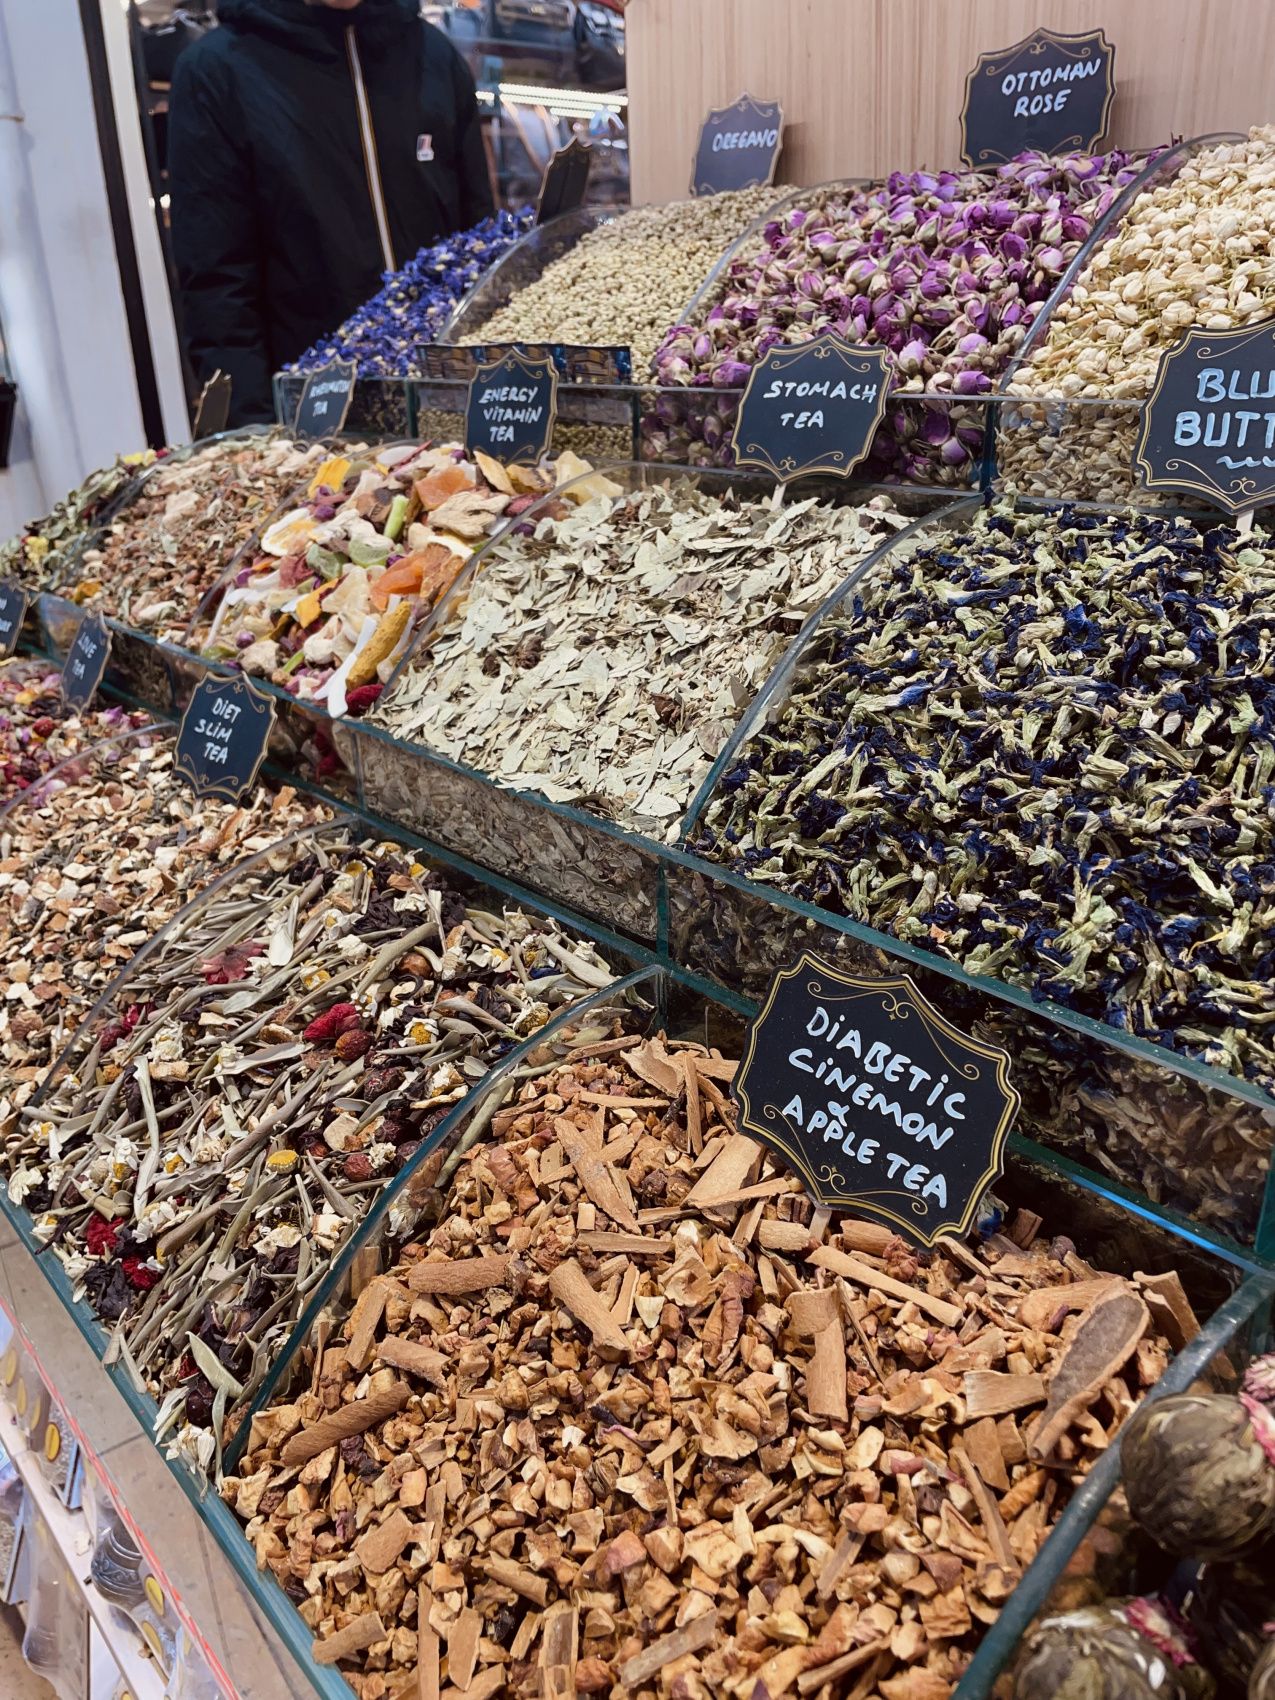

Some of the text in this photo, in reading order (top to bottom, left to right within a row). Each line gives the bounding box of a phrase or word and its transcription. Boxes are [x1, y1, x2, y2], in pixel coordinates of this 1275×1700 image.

[1001, 58, 1101, 96] OTTOMAN
[1013, 89, 1072, 117] ROSE
[478, 386, 539, 404] ENERGY
[763, 380, 877, 403] STOMACH
[780, 410, 824, 429] TEA
[489, 425, 515, 442] TEA
[203, 742, 229, 764] TEA
[782, 1094, 948, 1209] APPLE TEA
